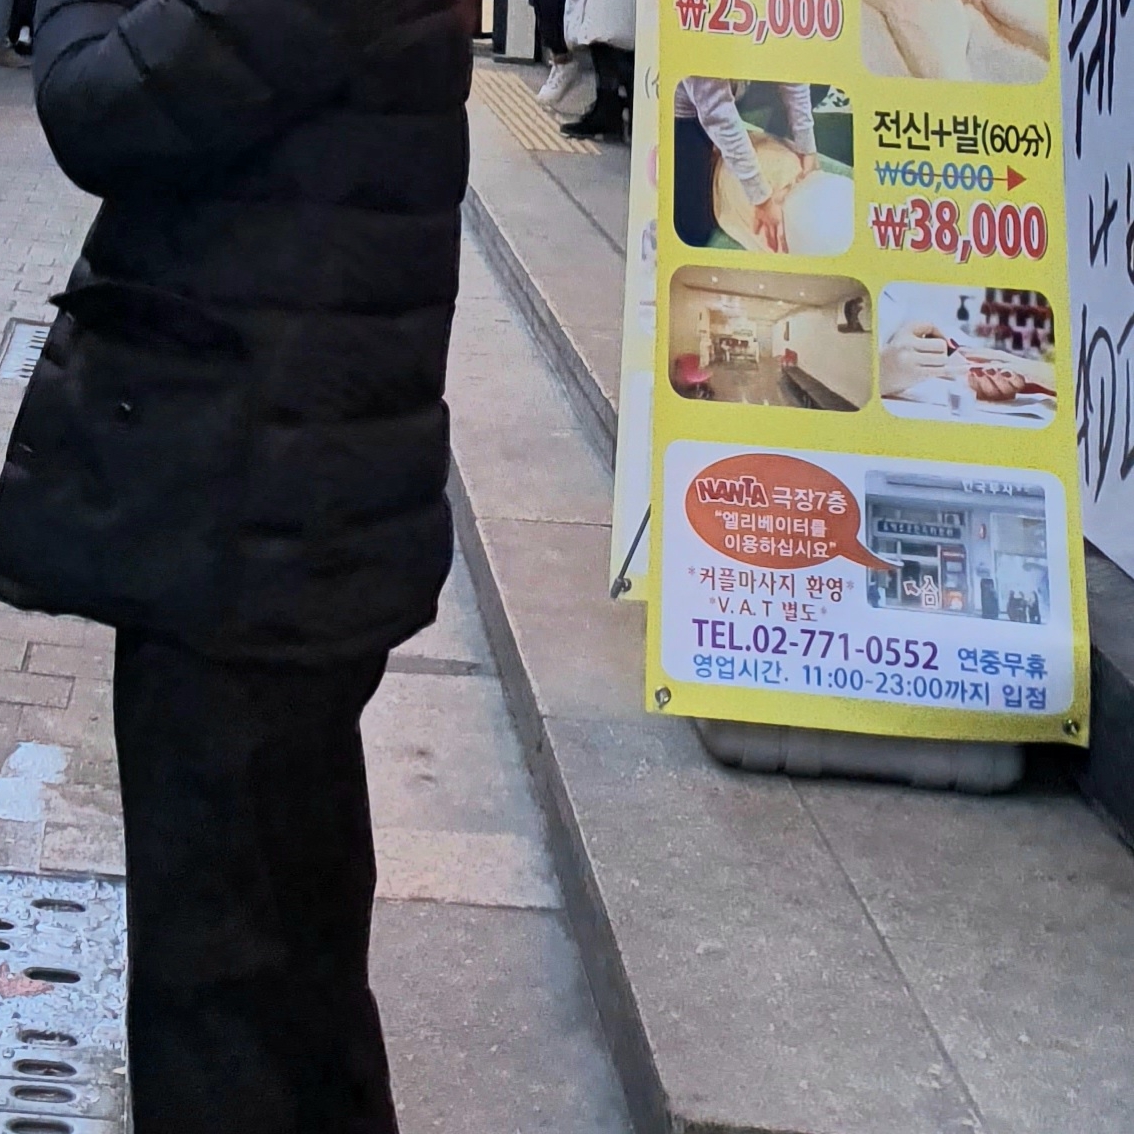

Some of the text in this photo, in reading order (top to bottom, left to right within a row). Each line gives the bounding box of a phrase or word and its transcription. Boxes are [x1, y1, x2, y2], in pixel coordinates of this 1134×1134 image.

[873, 109, 1052, 159] 전신+발(60分)
[871, 199, 1048, 263] ₩38,000
[696, 475, 848, 515] NANTA 극장7층
[699, 565, 844, 603] 커플마사지 환영
[782, 601, 818, 623] 별도
[692, 618, 1048, 678] TEL.02-771-0552 연중무휴
[1003, 685, 1047, 711] 입점
